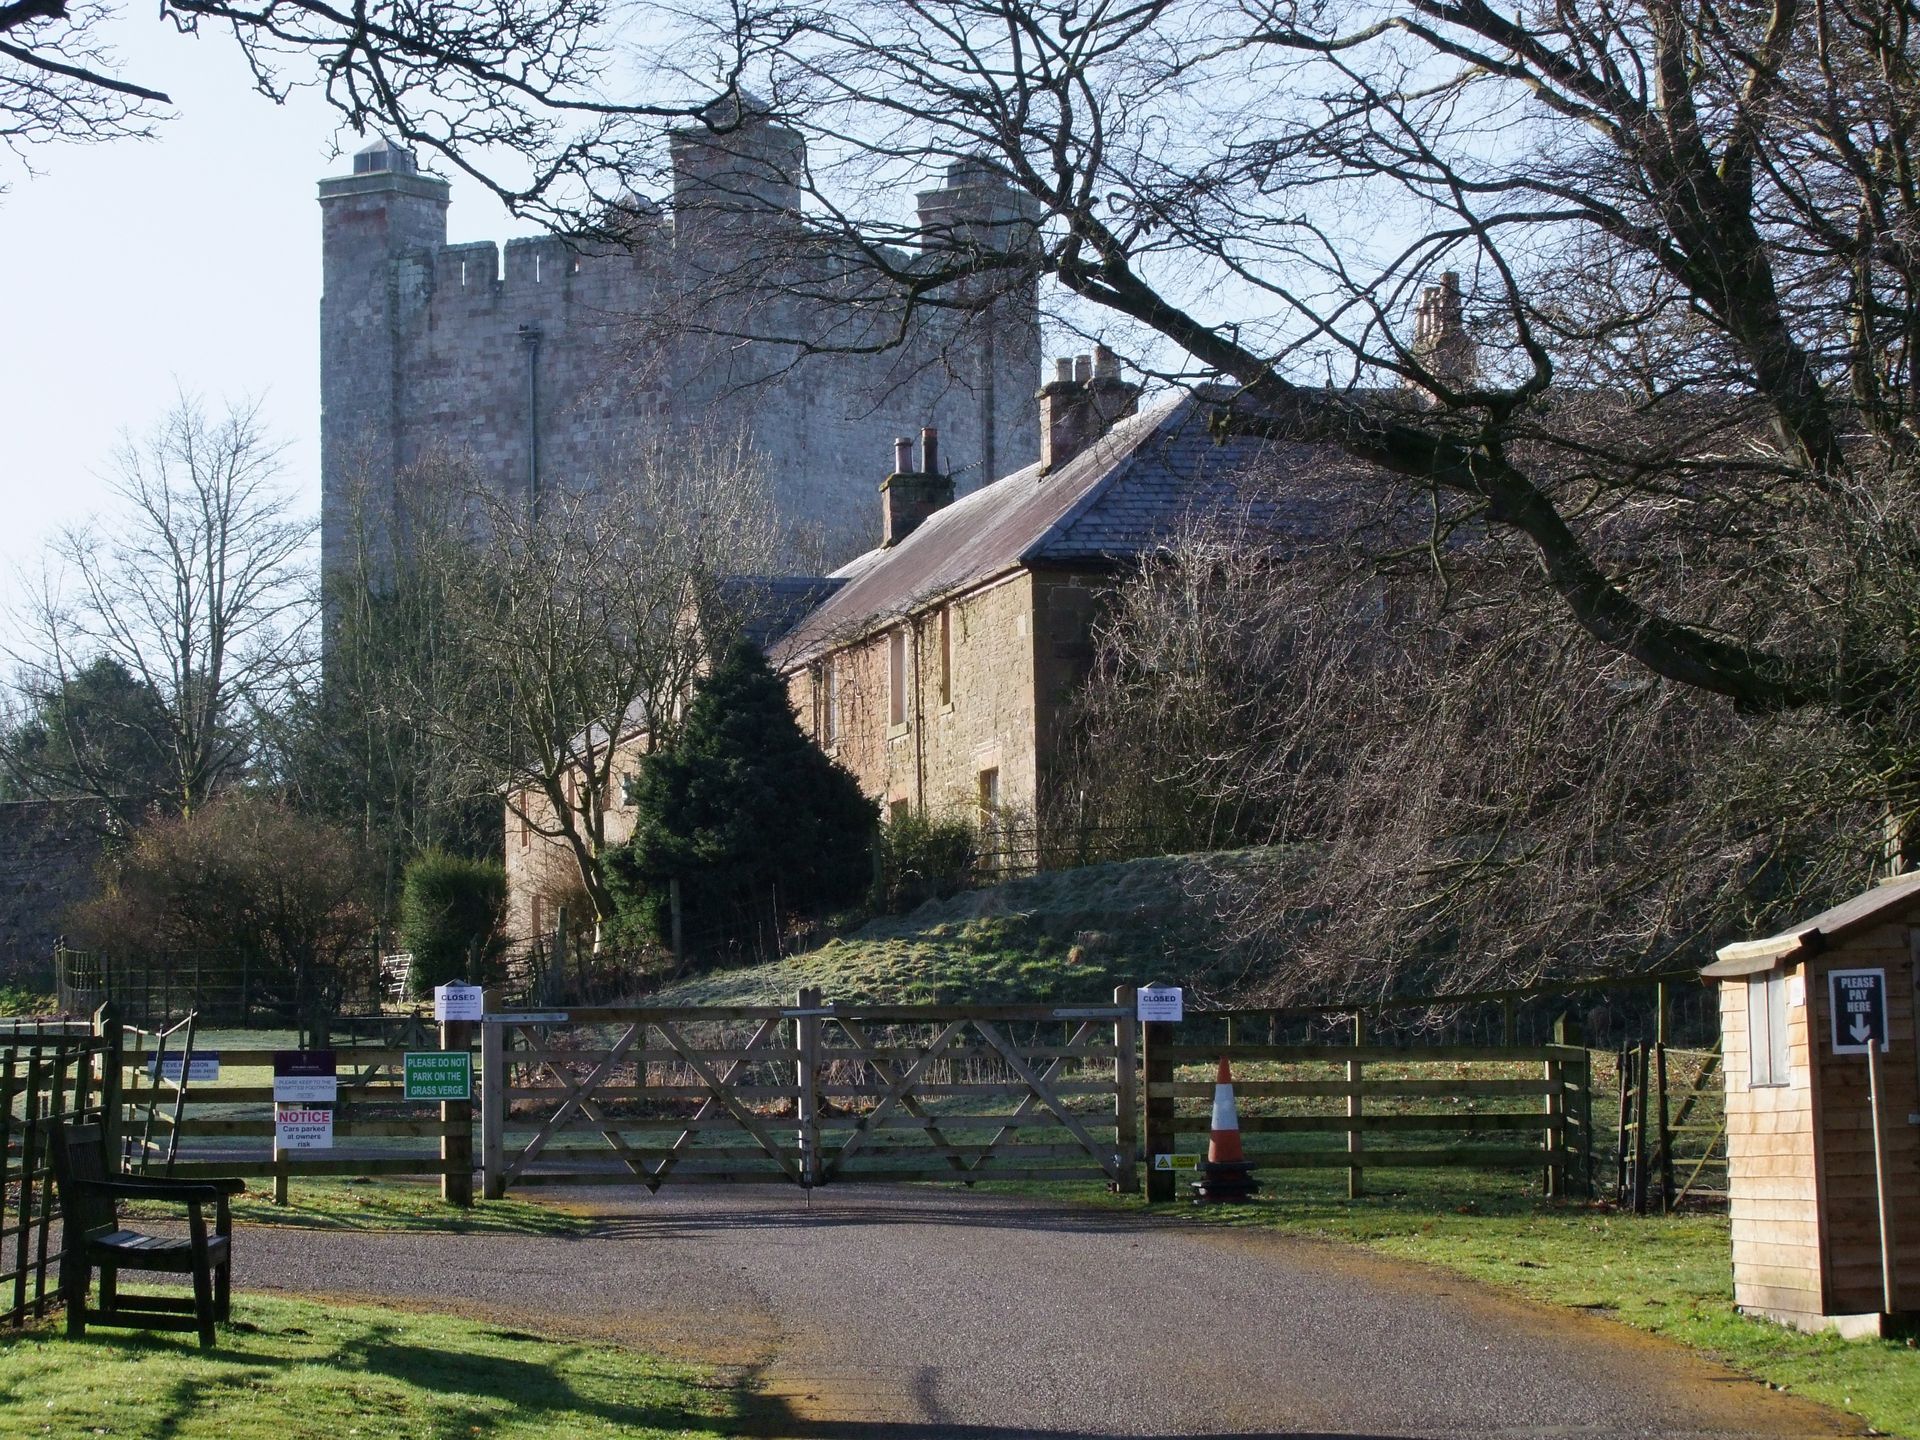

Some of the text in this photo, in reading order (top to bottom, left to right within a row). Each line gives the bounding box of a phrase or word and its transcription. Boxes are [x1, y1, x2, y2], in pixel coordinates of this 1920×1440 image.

[1841, 977, 1874, 988] PLEASE
[1849, 990, 1867, 1000] PAY
[1847, 1001, 1871, 1012] HERE
[408, 1058, 466, 1067] PLEASE DO NOT
[412, 1072, 461, 1081] PARK ON THE
[411, 1085, 464, 1095] GRASS VERGE
[279, 1111, 330, 1123] NOTICE
[282, 1125, 326, 1133] Cars parked
